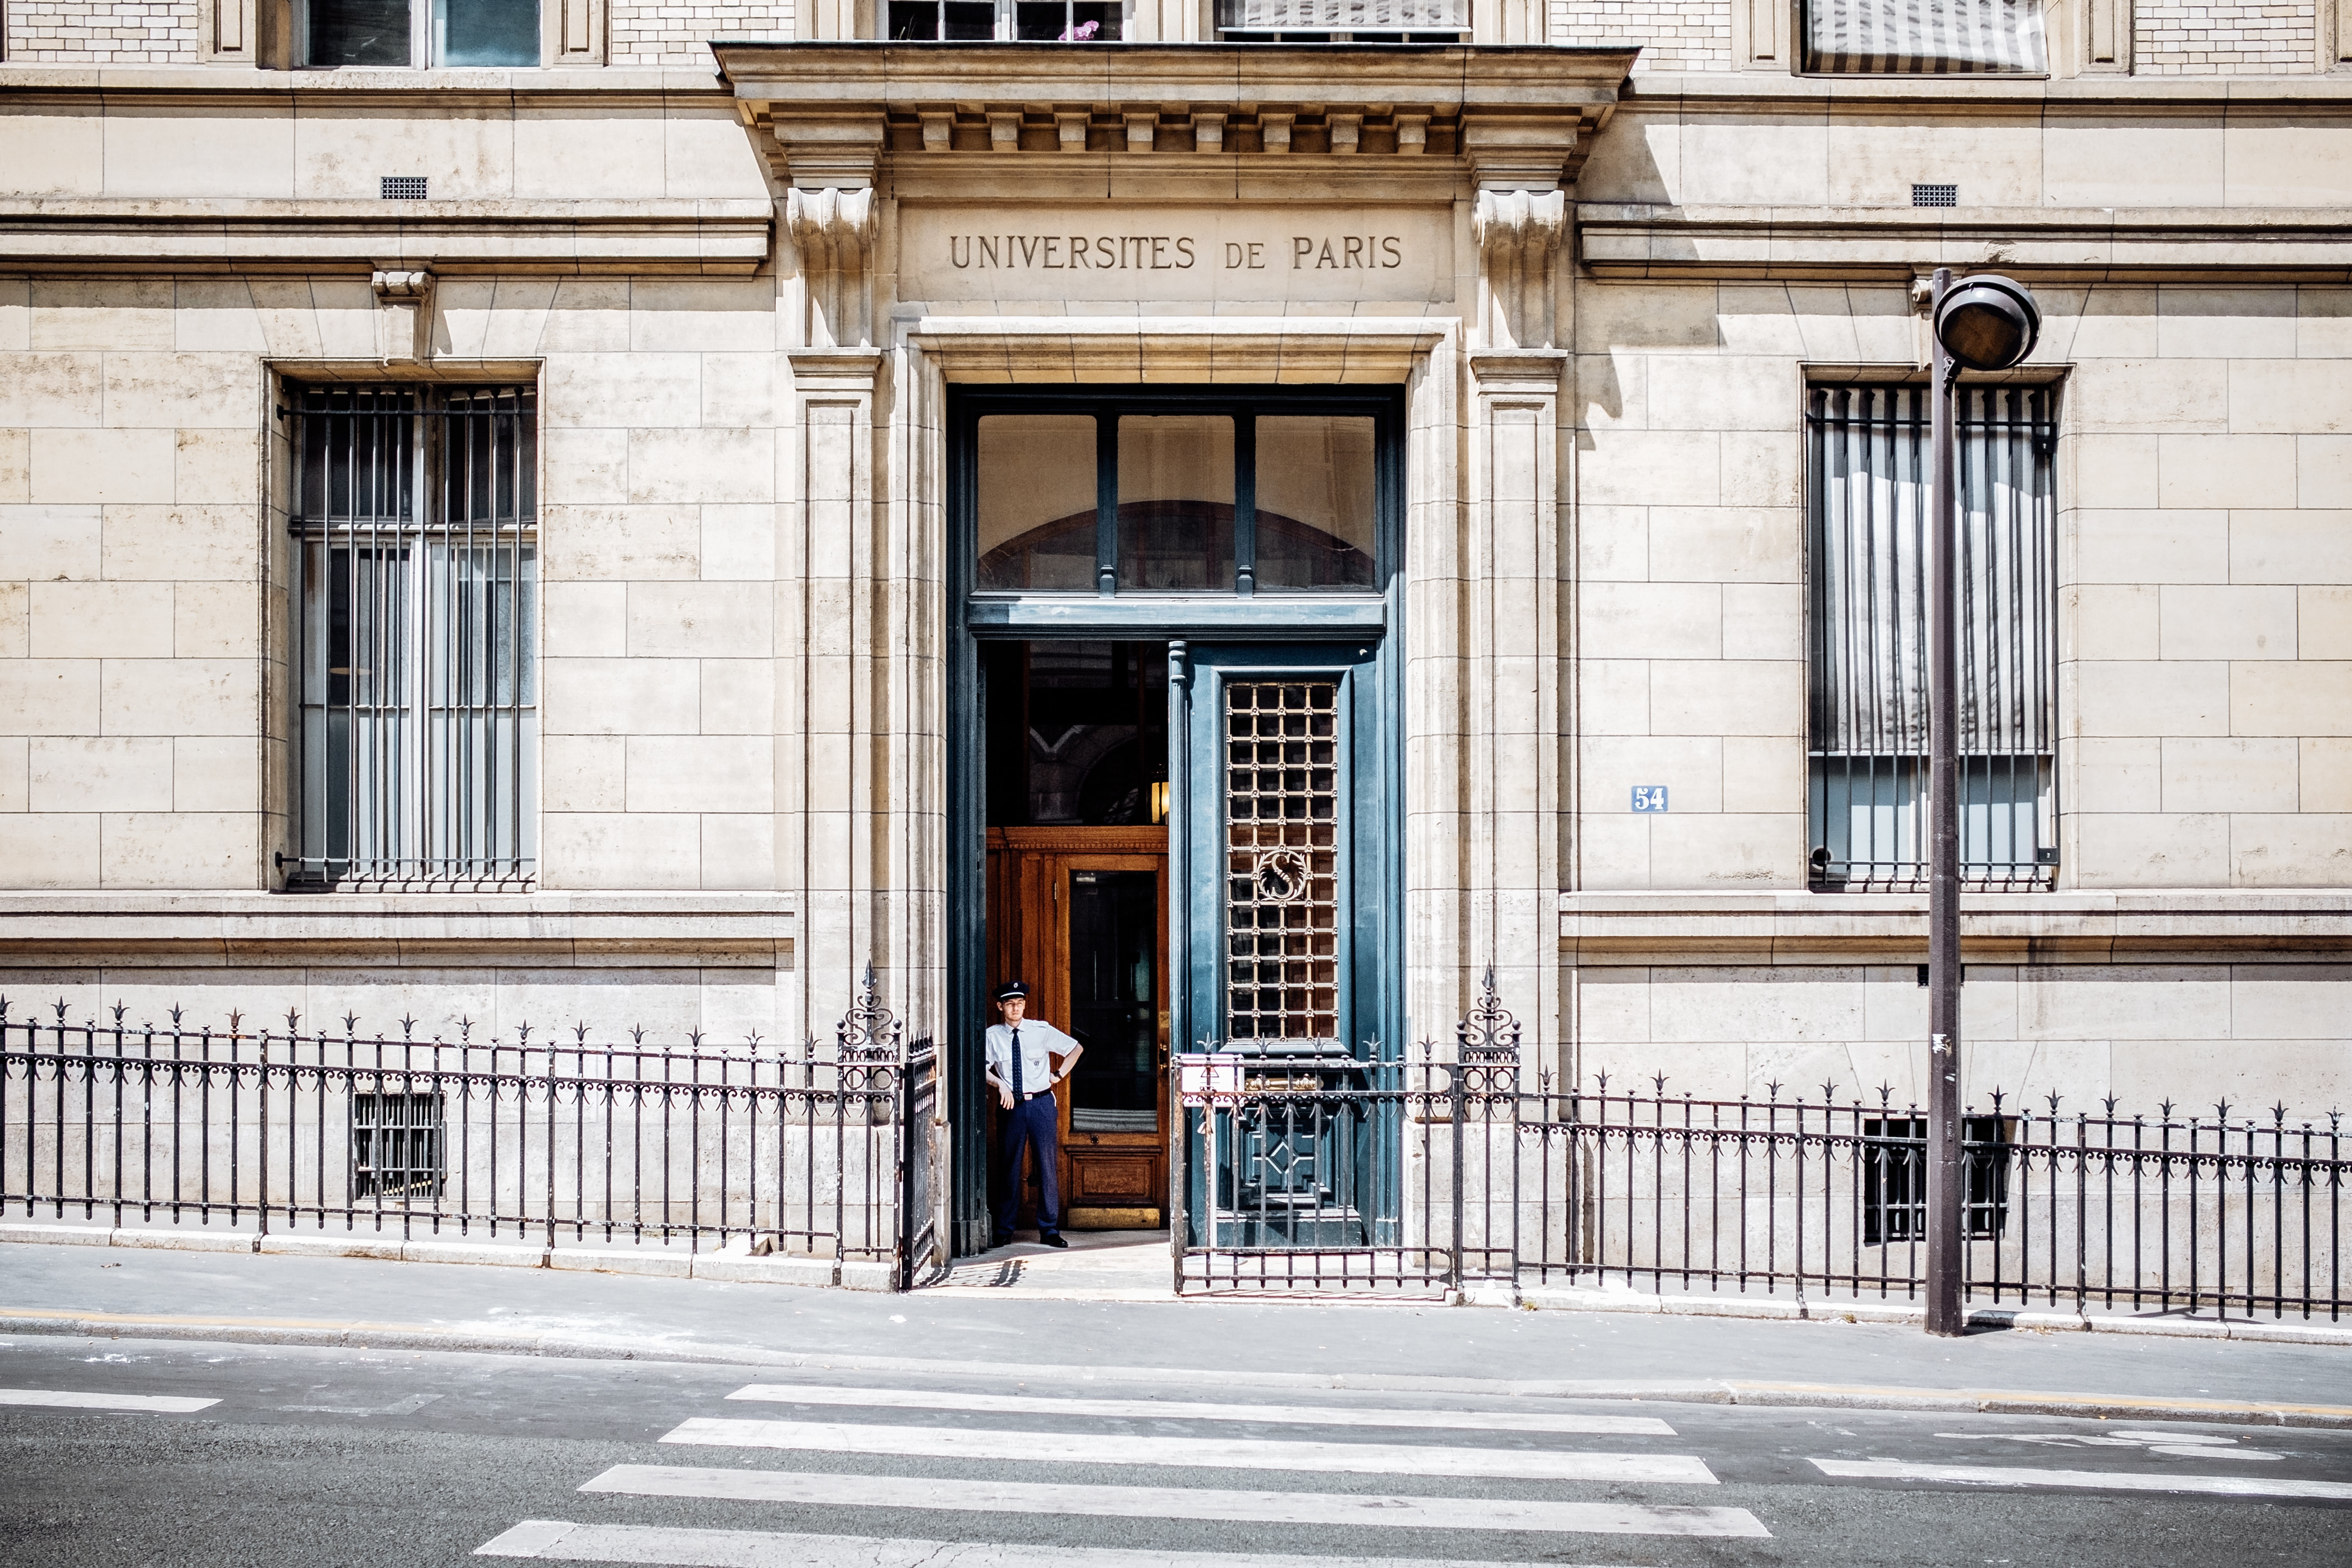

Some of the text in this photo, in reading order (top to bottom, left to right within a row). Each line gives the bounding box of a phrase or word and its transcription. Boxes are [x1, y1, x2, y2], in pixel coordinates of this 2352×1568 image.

[950, 236, 1402, 270] UNIVERSITES DE PARIS
[1635, 787, 1664, 810] 54
